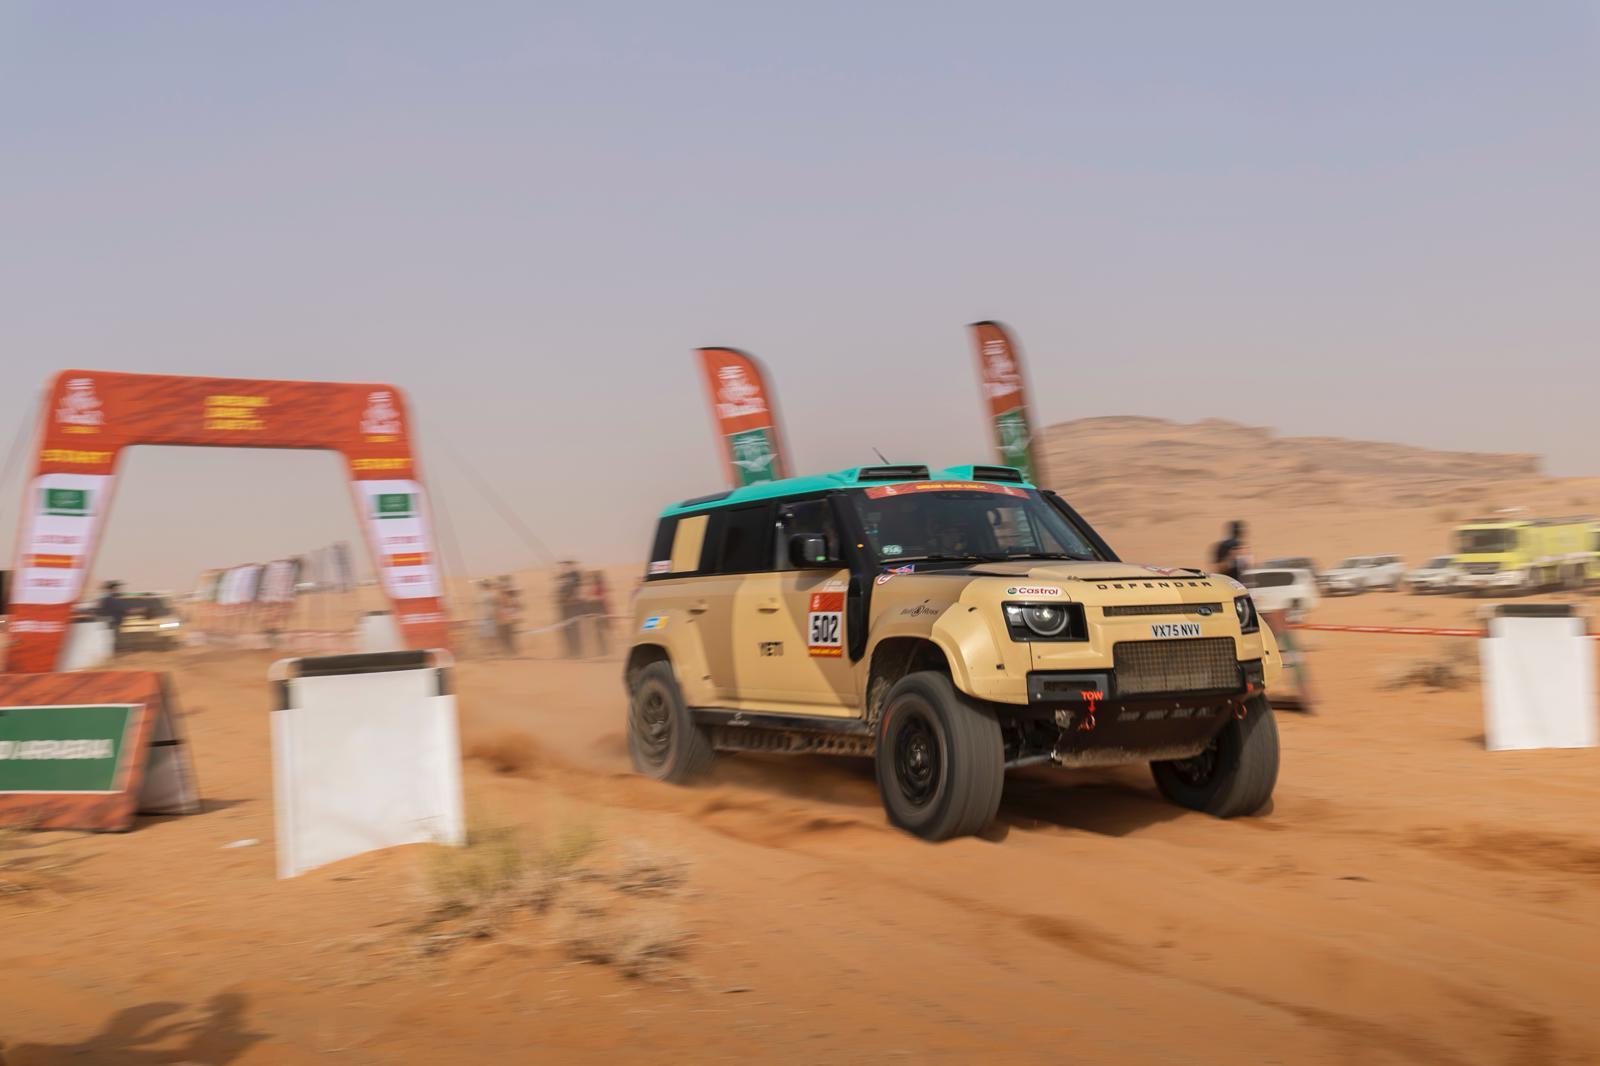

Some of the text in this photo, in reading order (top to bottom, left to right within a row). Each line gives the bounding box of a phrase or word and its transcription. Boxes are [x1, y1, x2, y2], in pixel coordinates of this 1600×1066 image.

[1096, 581, 1213, 591] DEFENDER
[1018, 587, 1059, 596] Castrol
[812, 614, 839, 643] 502
[1151, 623, 1200, 638] VX75 NVV
[1081, 691, 1103, 701] TOW
